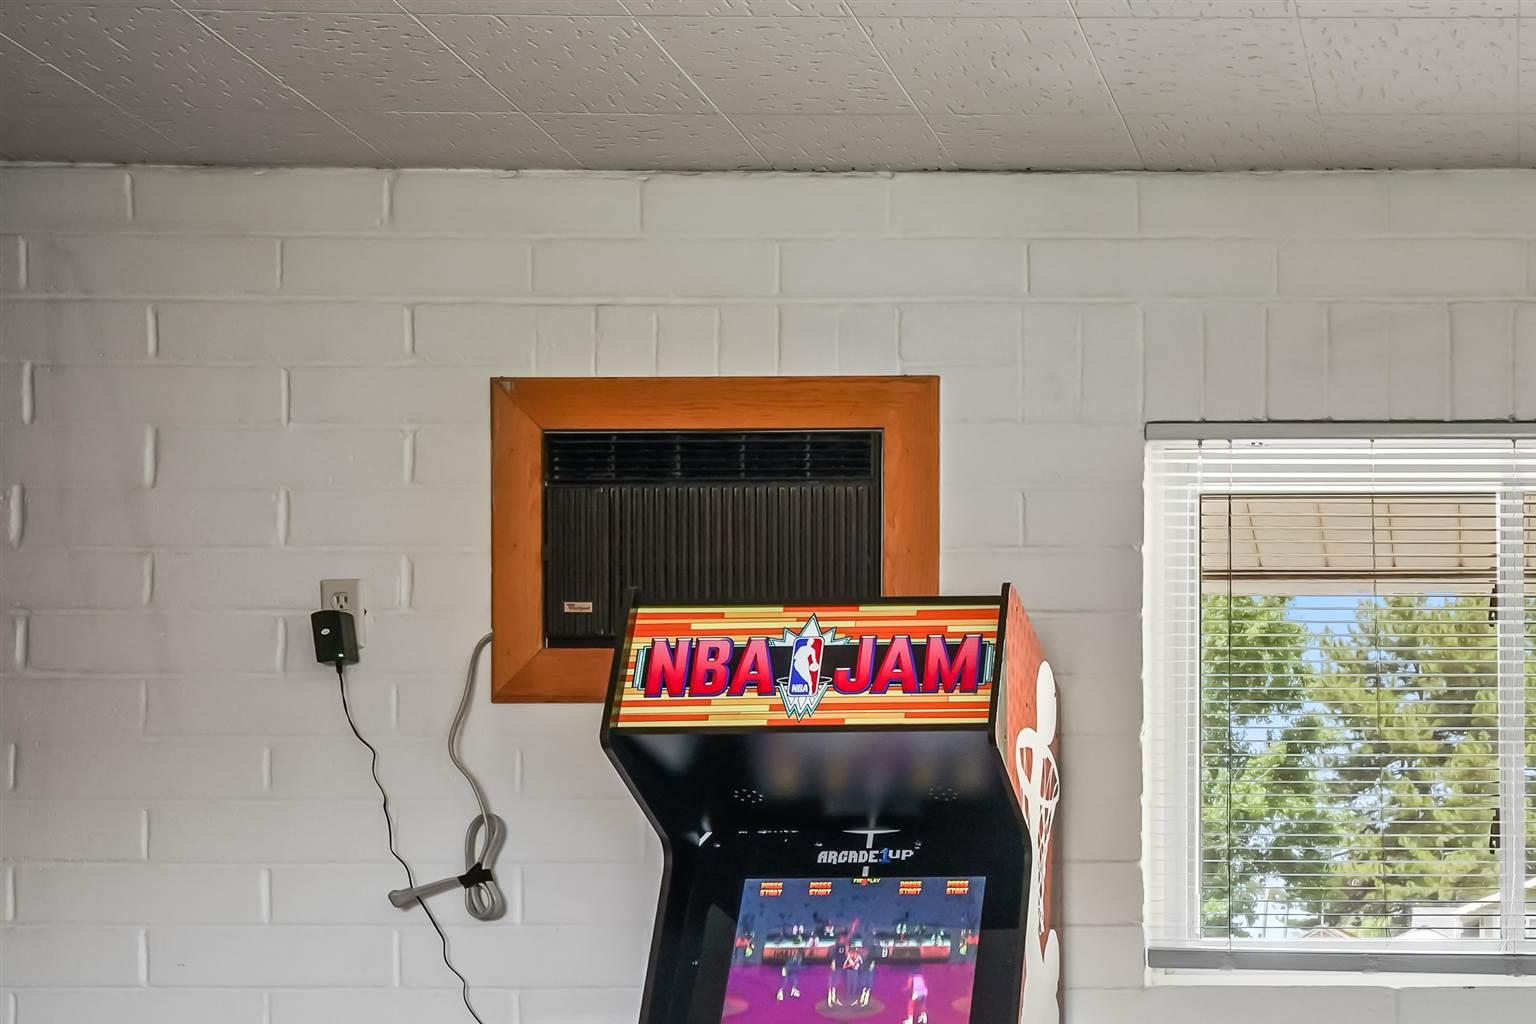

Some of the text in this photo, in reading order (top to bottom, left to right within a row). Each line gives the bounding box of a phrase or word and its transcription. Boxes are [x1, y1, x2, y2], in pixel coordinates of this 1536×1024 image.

[643, 633, 985, 698] NBA JAM
[791, 683, 809, 693] NBA
[759, 889, 783, 897] START
[808, 888, 832, 896] START
[899, 887, 922, 895] START
[945, 887, 969, 895] START
